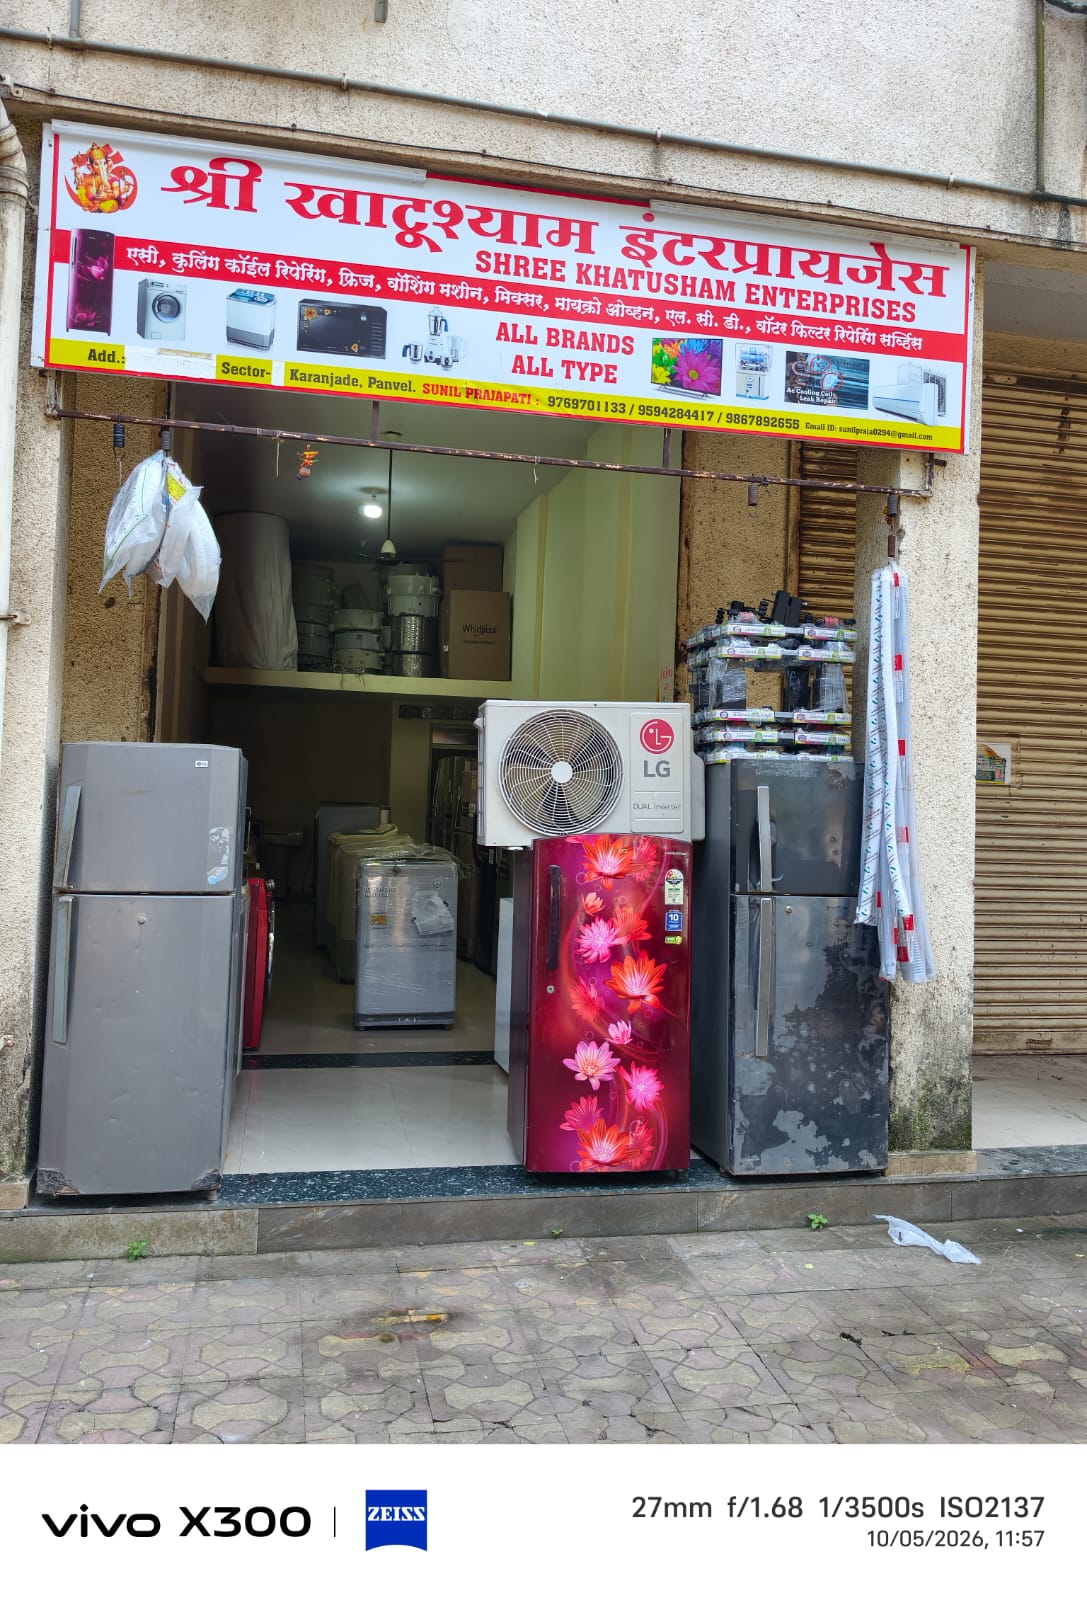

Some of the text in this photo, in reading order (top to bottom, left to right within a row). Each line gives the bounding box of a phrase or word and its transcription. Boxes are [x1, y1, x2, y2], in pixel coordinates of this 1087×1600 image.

[161, 157, 949, 298] श्री खाटूश्याम इंटरप्रायजेस
[127, 246, 166, 268] एसी,
[172, 250, 220, 273] कुलिंग
[224, 255, 271, 279] कॉईल
[275, 261, 333, 287] रिपेरिंग,
[339, 268, 382, 292] फ्रिज,
[387, 273, 435, 295] वॉशिंग
[440, 282, 489, 305] मशीन,
[494, 286, 549, 311] मिक्सर,
[555, 296, 602, 315] मायक्रो
[606, 302, 660, 324] ओव्हन,
[756, 315, 788, 336] वॉटर
[790, 320, 831, 340] फिल्टर
[834, 325, 876, 346] रिपेरिंग
[880, 332, 923, 351] सर्व्हिस
[475, 250, 916, 323] SHREE KHATUSHAM ENTERPRISES
[496, 322, 636, 355] ALL BRANDS
[87, 348, 271, 378] Add.: Sector-
[511, 354, 618, 384] ALL TYPE
[289, 368, 363, 388] Karanjade,
[367, 376, 416, 393] Panvel.
[422, 383, 462, 399] SUNIL
[465, 387, 531, 405] PRAJAPATI
[547, 396, 626, 414] 9769701133
[638, 405, 714, 423] 9594284417
[725, 412, 800, 430] 9867892655
[805, 422, 825, 431] Email
[463, 624, 496, 634] Whirlpool
[643, 759, 671, 778] LG
